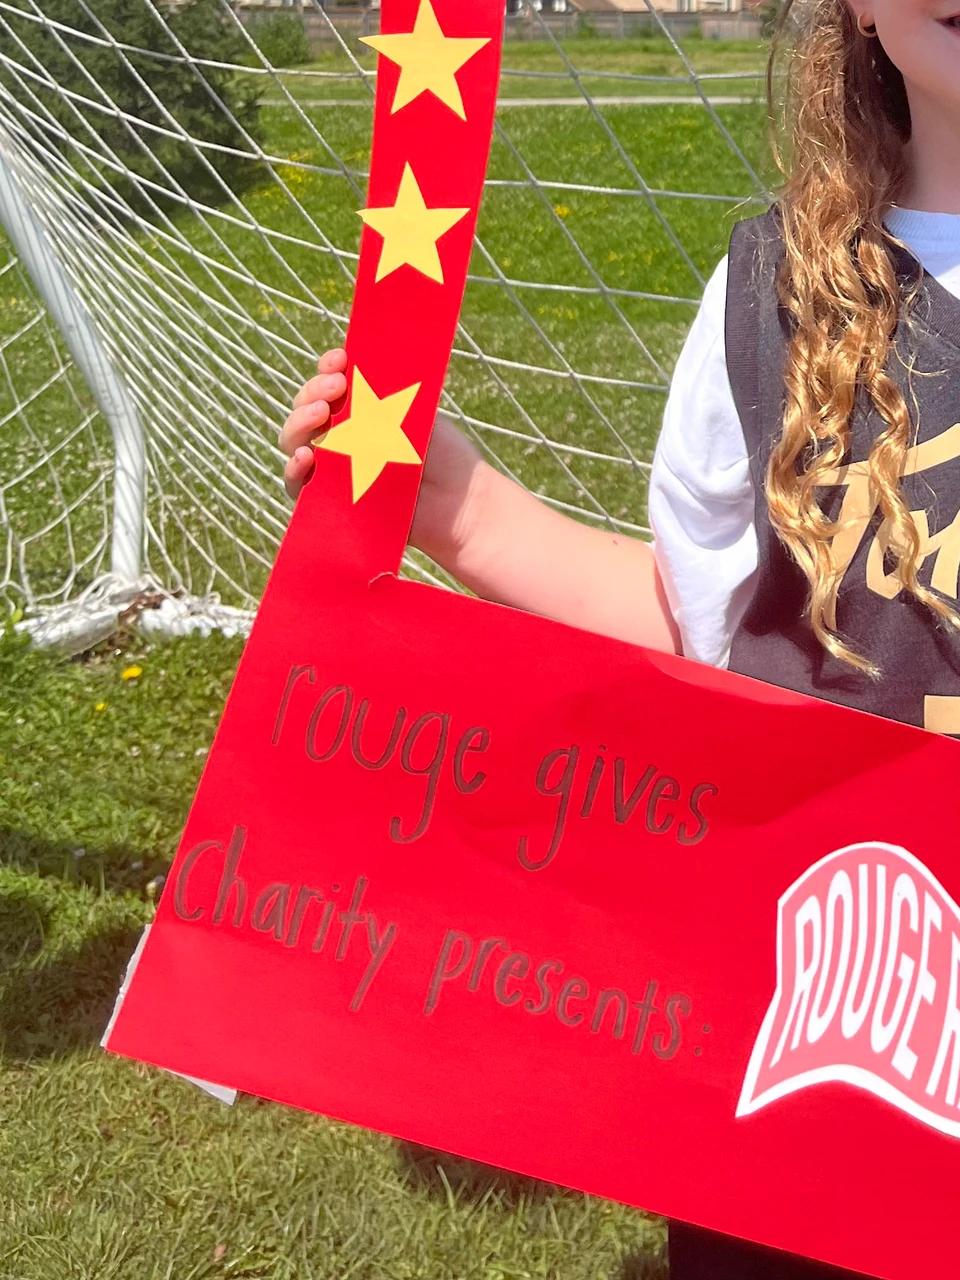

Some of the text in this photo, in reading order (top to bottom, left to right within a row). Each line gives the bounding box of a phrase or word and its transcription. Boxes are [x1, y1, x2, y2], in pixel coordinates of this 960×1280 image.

[272, 664, 719, 871] rouge gives
[424, 929, 711, 1059] presents:
[769, 863, 943, 1081] ROUGE
